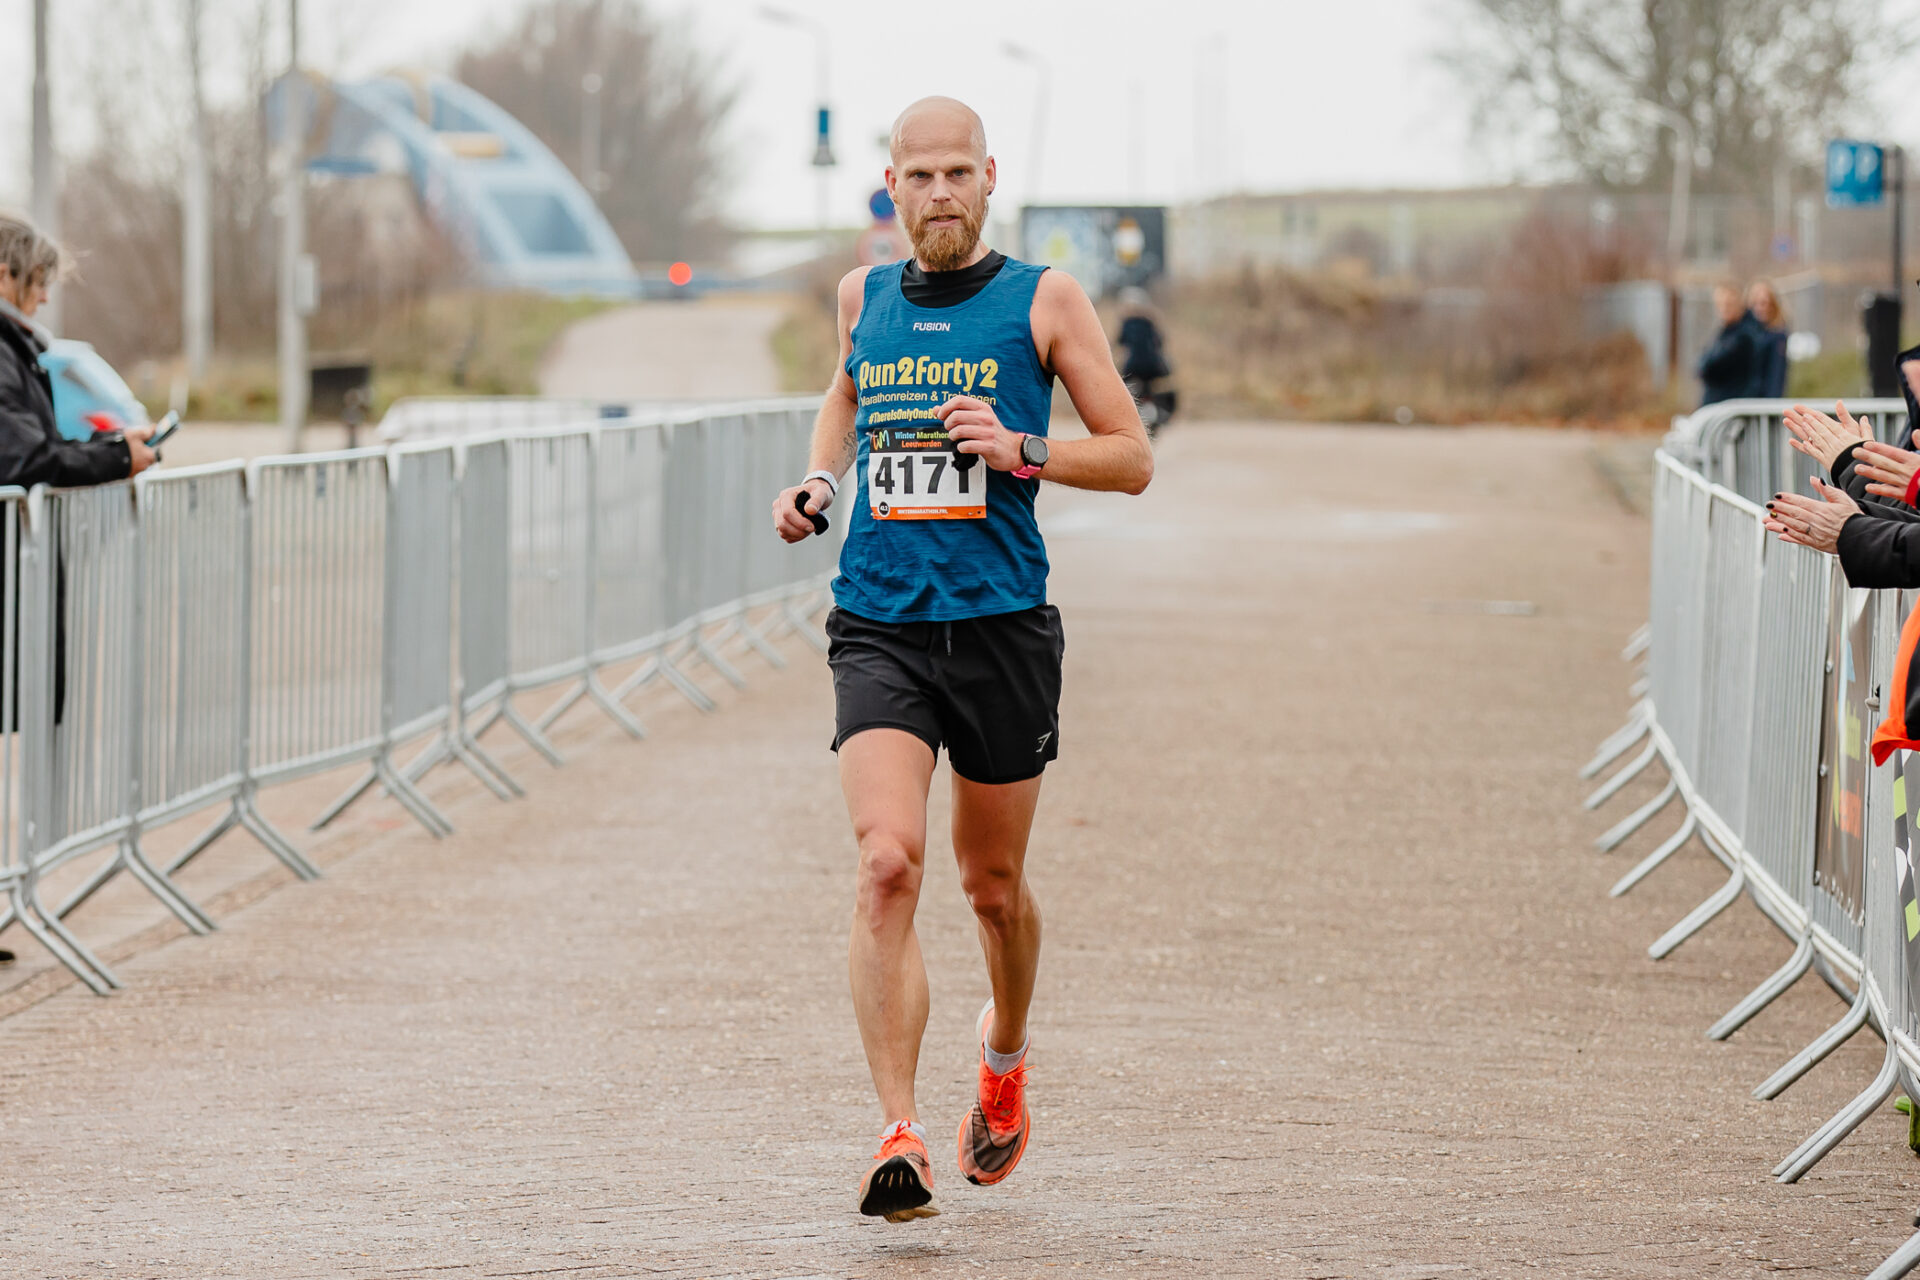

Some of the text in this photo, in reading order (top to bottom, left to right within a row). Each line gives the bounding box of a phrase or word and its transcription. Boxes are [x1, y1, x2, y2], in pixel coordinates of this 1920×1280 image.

[913, 322, 951, 332] FUSION
[859, 356, 999, 392] Run2Forty2
[861, 391, 927, 407] Marathonreizen
[930, 391, 938, 401] &
[868, 408, 938, 424] #ThereIsOnlyOneB
[895, 431, 950, 439] Winter Marathon
[875, 456, 969, 494] 4171
